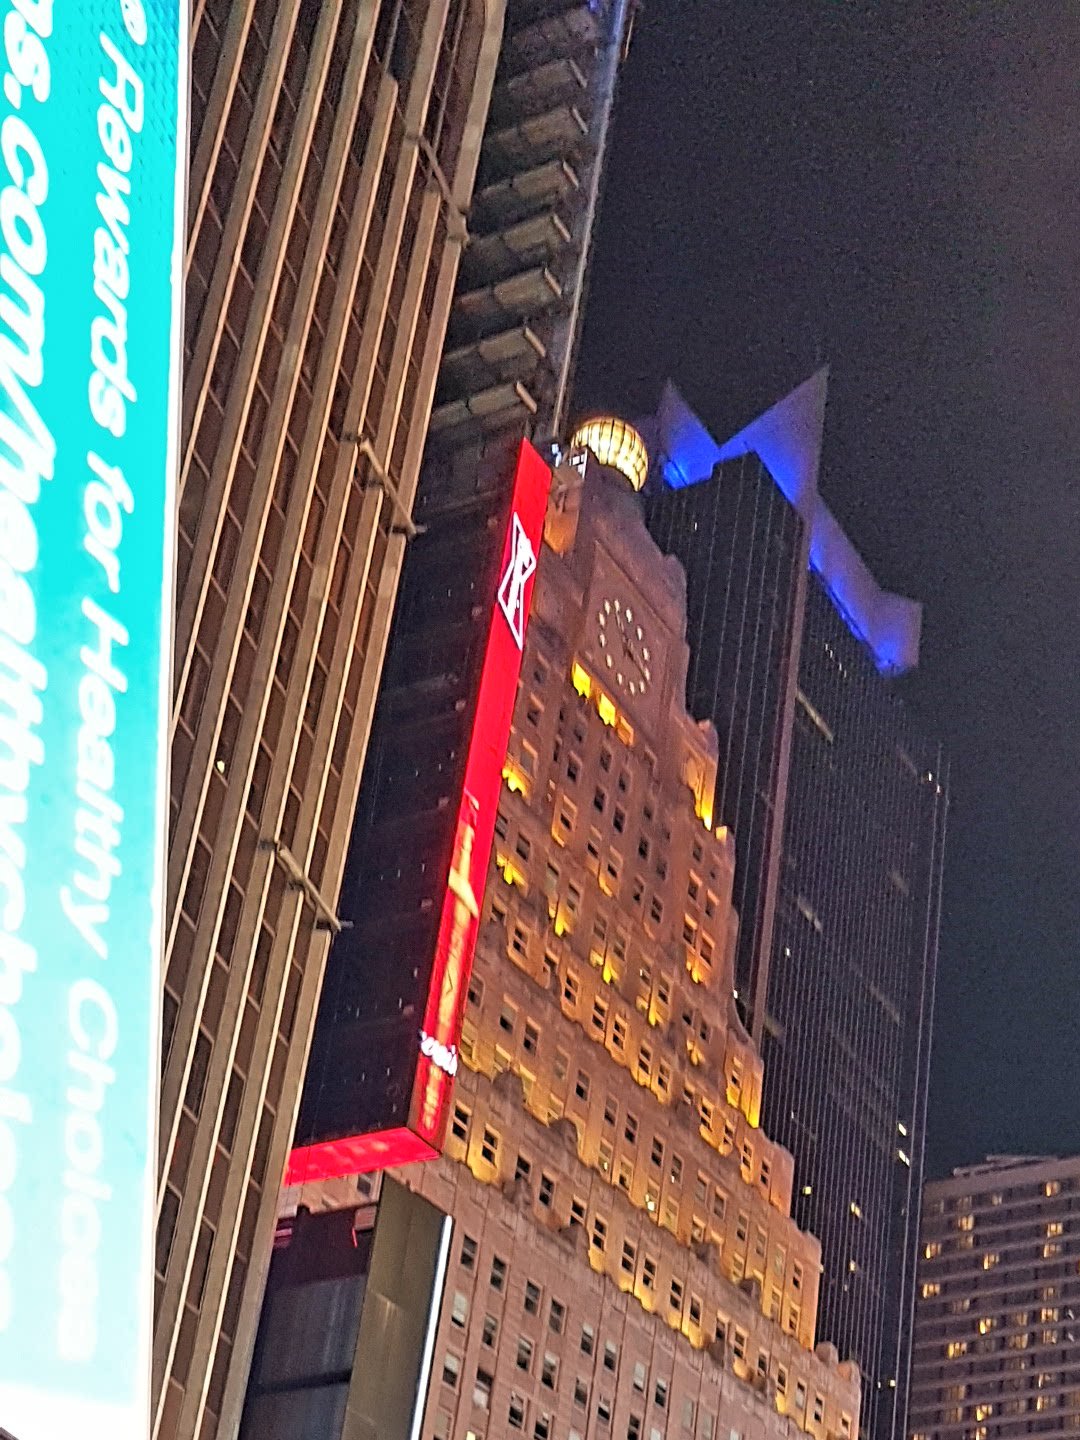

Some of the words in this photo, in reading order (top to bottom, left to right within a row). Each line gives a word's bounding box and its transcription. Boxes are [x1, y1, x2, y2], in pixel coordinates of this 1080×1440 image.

[88, 31, 144, 438] Rewards
[83, 449, 135, 594] for
[60, 596, 130, 961] Healthy
[57, 977, 119, 1361] Choices
